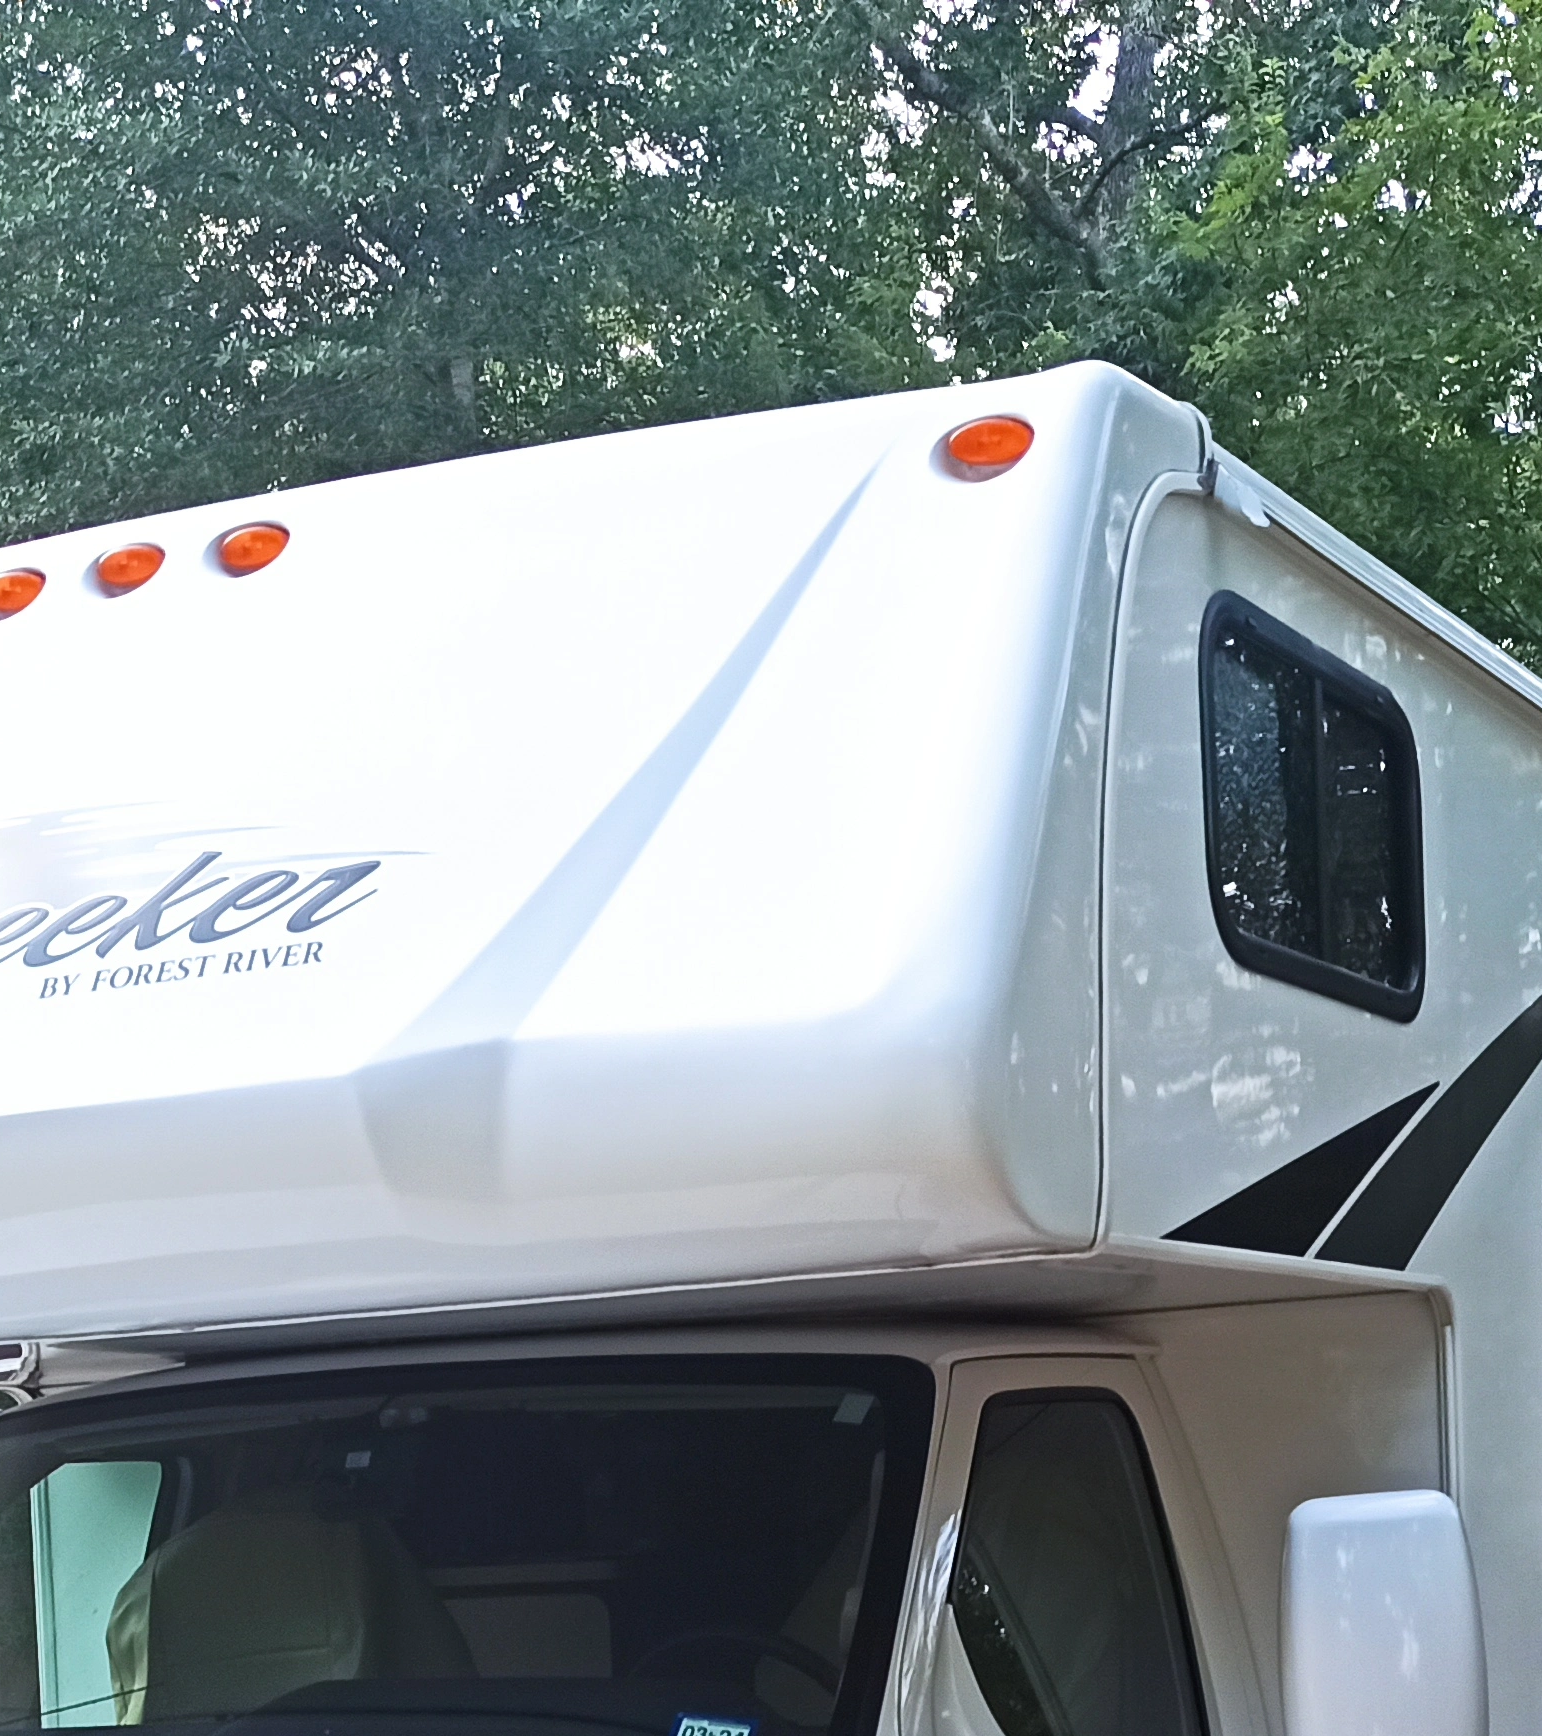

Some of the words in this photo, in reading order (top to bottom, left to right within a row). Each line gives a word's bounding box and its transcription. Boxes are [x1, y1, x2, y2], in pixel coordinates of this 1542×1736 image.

[39, 974, 82, 1000] BY
[91, 954, 218, 992] FOREST
[223, 941, 324, 975] RIVER
